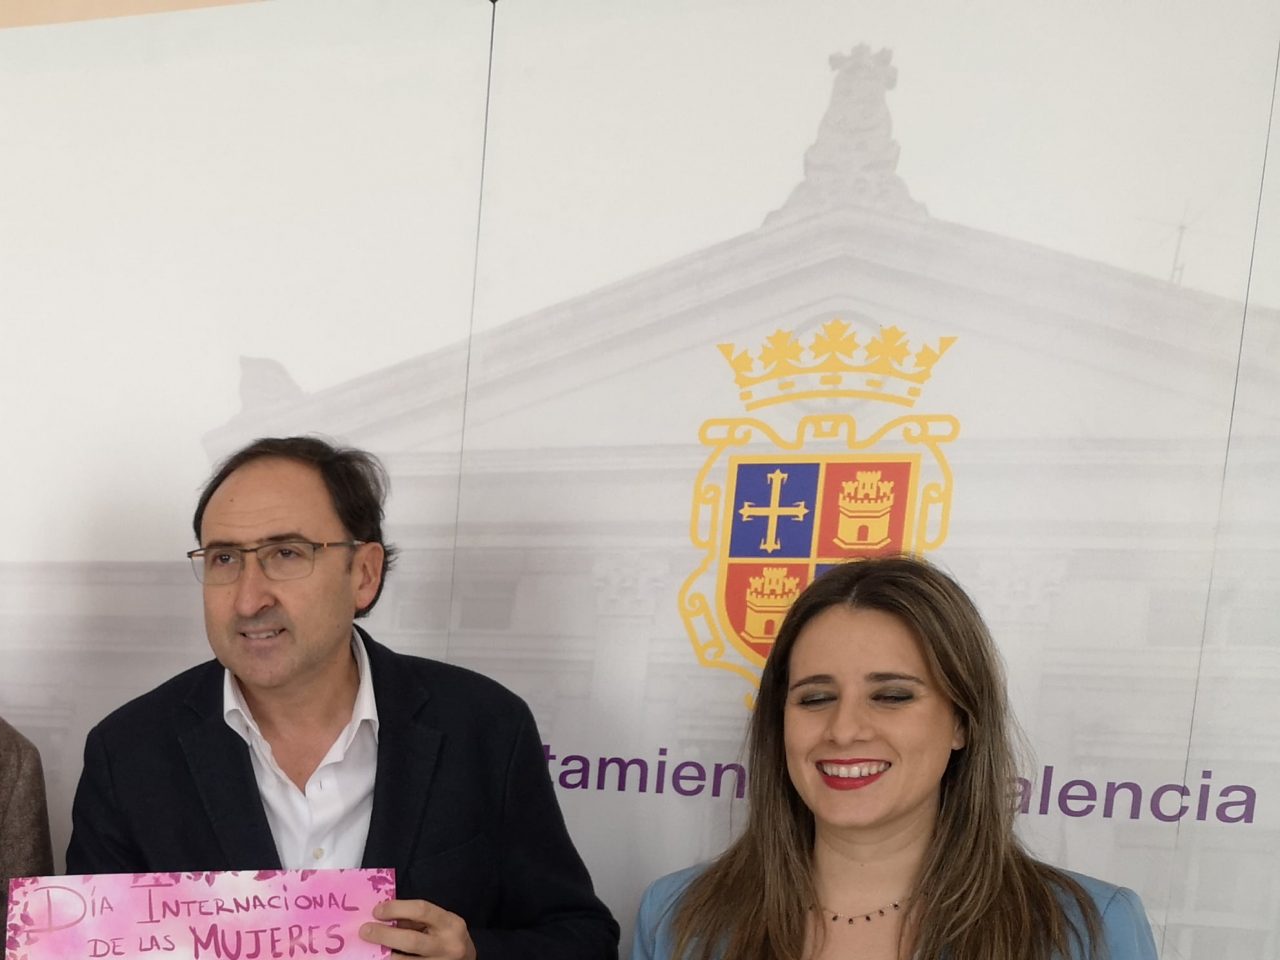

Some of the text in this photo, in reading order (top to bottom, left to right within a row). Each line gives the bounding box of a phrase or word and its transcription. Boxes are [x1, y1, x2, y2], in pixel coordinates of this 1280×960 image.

[88, 924, 346, 960] DE LAS MUJERES
